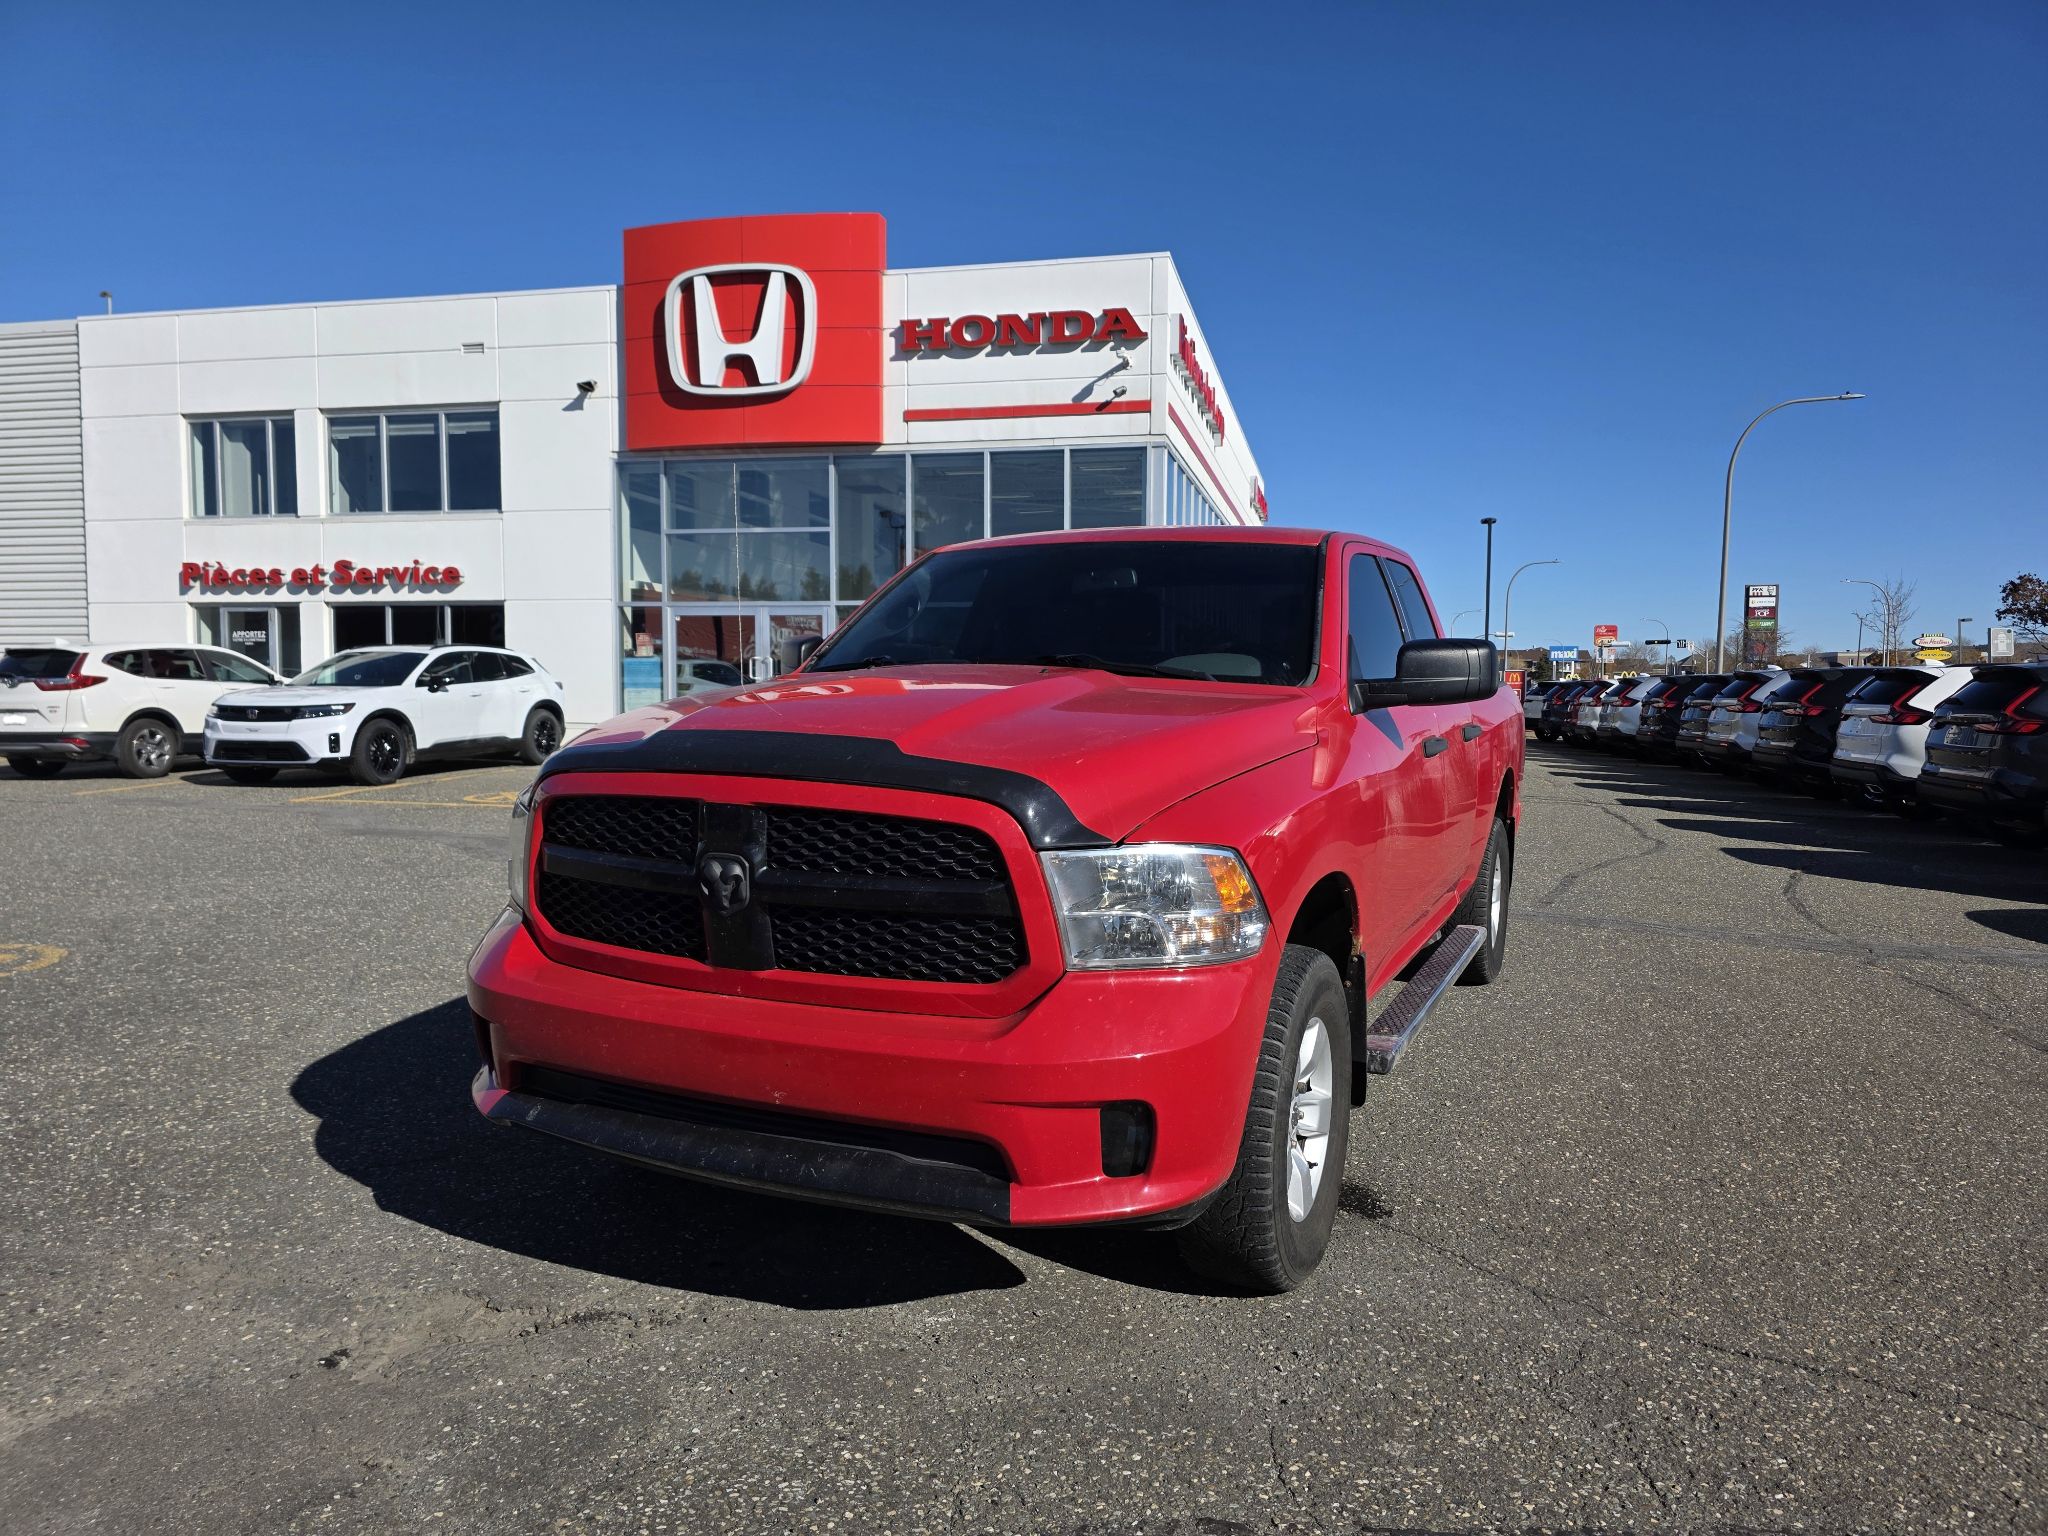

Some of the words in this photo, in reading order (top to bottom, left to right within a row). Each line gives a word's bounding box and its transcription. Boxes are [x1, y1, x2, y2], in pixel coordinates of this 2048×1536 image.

[900, 307, 1149, 351] HONDA
[181, 561, 283, 588] Pièces
[291, 563, 325, 586] et
[333, 559, 461, 586] Service
[232, 630, 266, 638] APPORTEZ
[1550, 648, 1577, 659] maxi
